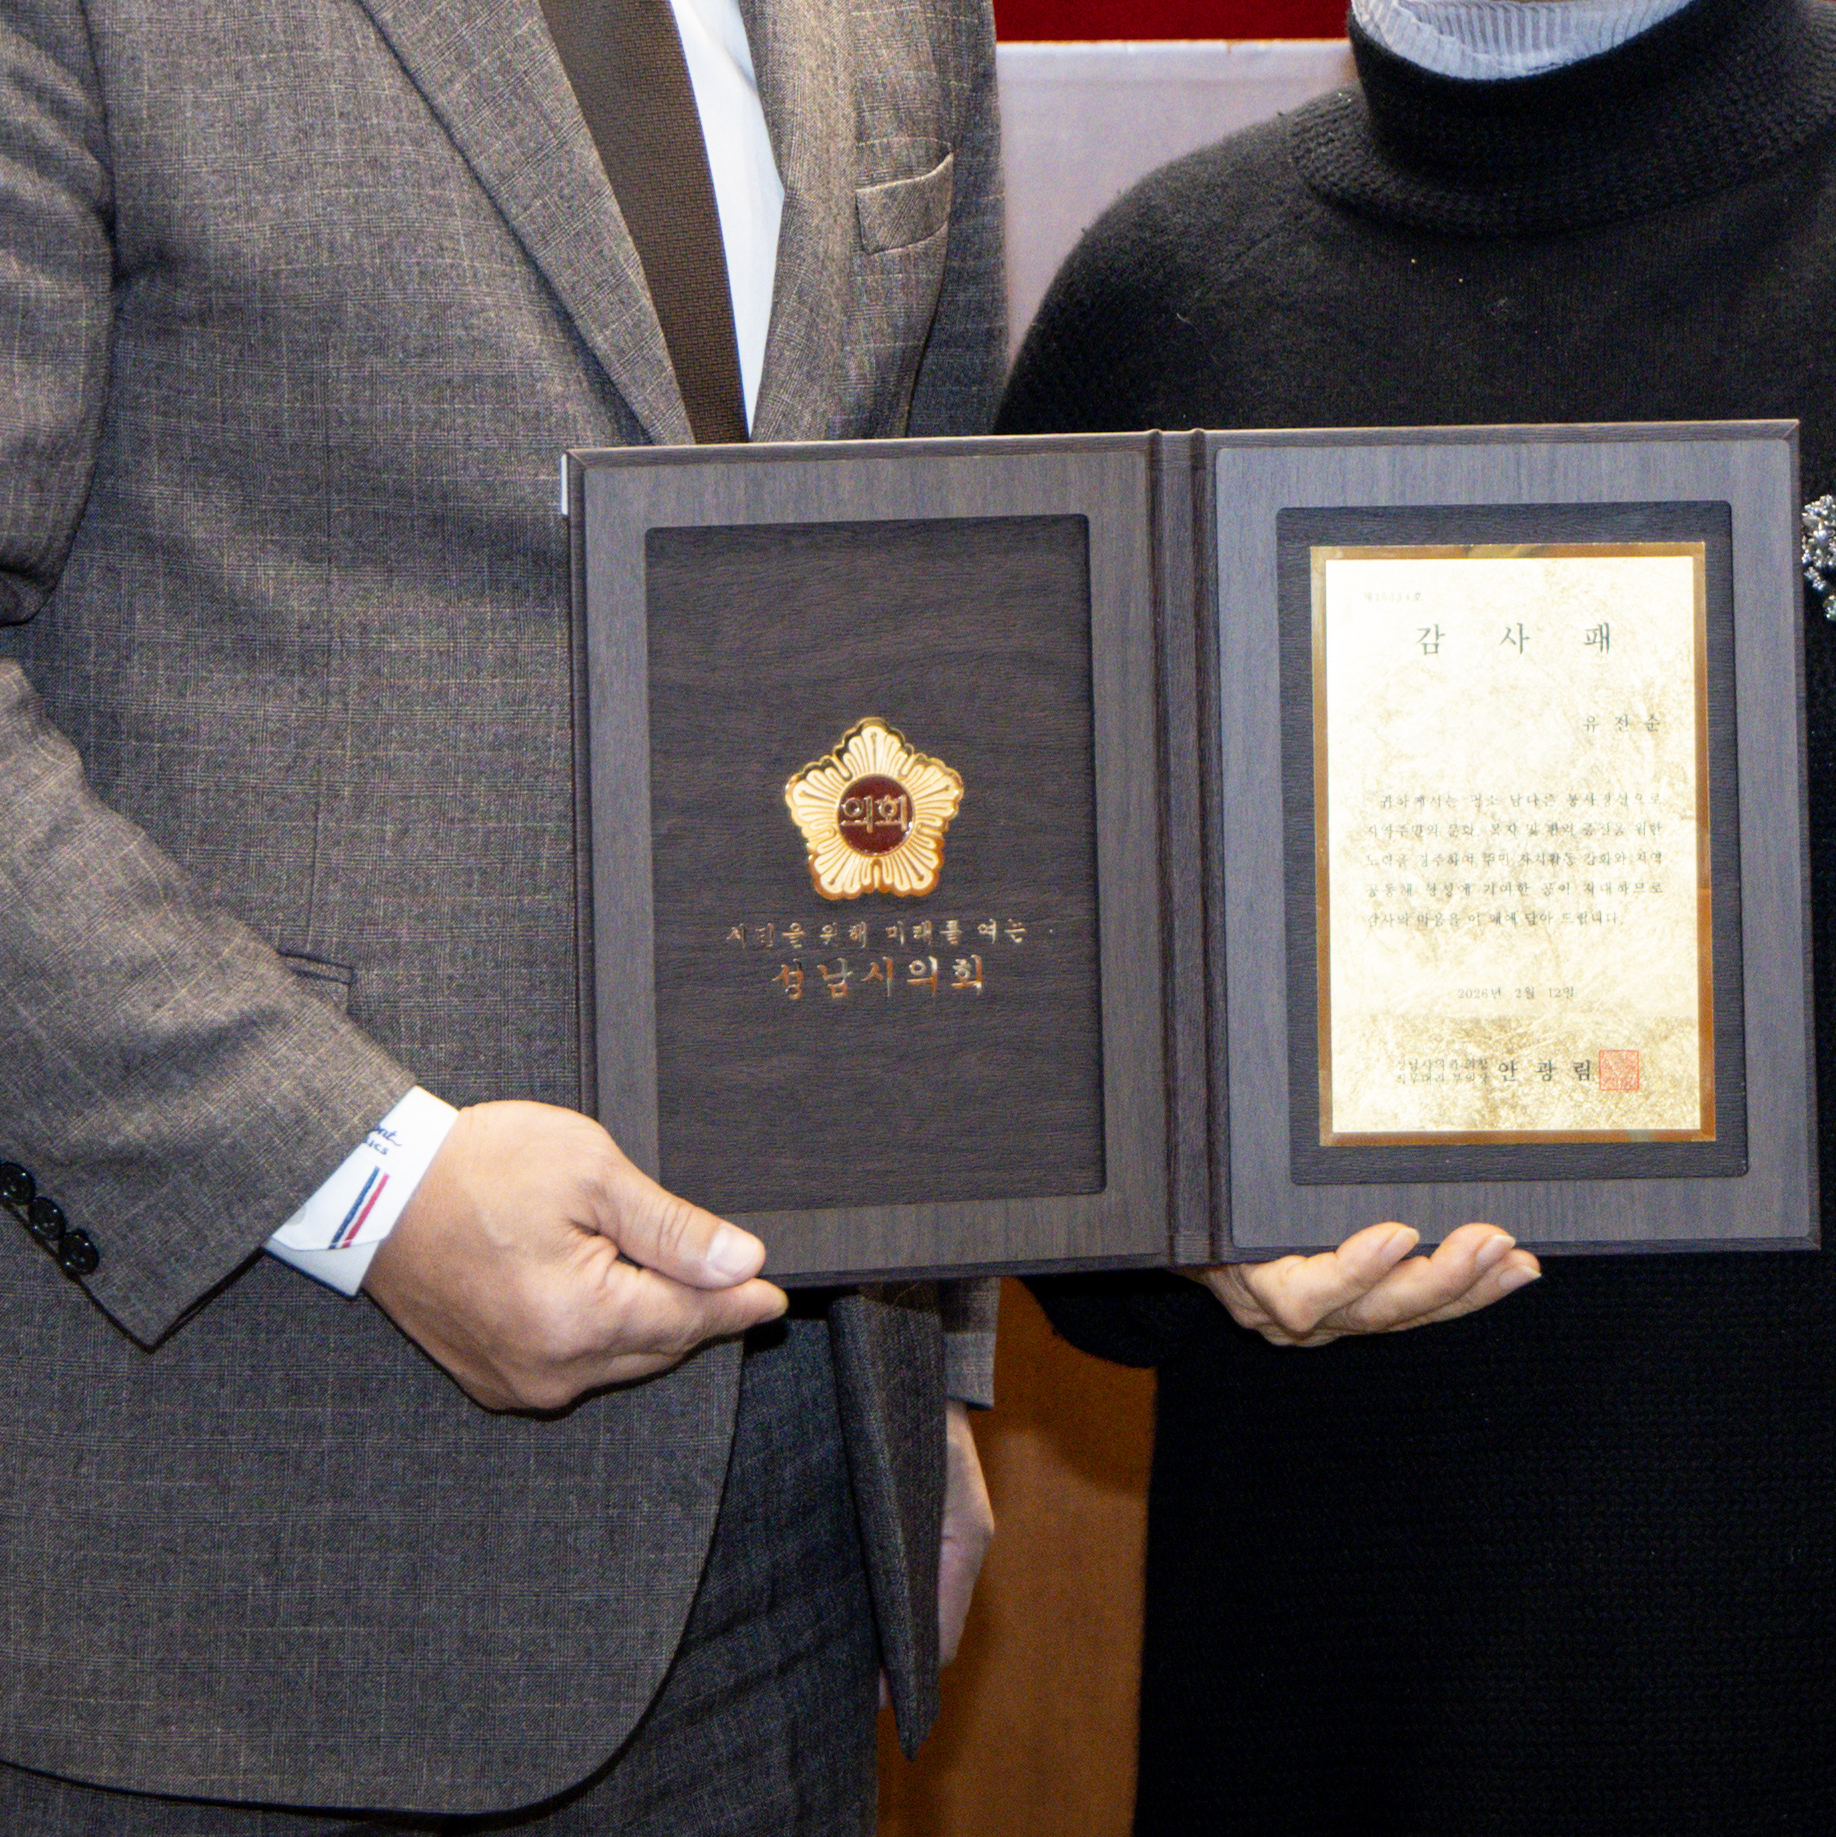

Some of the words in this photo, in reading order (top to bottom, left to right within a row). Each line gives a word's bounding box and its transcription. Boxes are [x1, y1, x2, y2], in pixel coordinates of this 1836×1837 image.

[1415, 621, 1613, 656] 감사패
[840, 794, 907, 833] 의회
[726, 922, 806, 949] 시민을
[819, 920, 867, 948] 위해
[885, 919, 963, 946] 미래를
[977, 918, 1028, 945] 여는
[771, 954, 983, 1000] 성남시의회
[1457, 985, 1503, 1000] 2026년
[1497, 1058, 1593, 1083] 안광림
